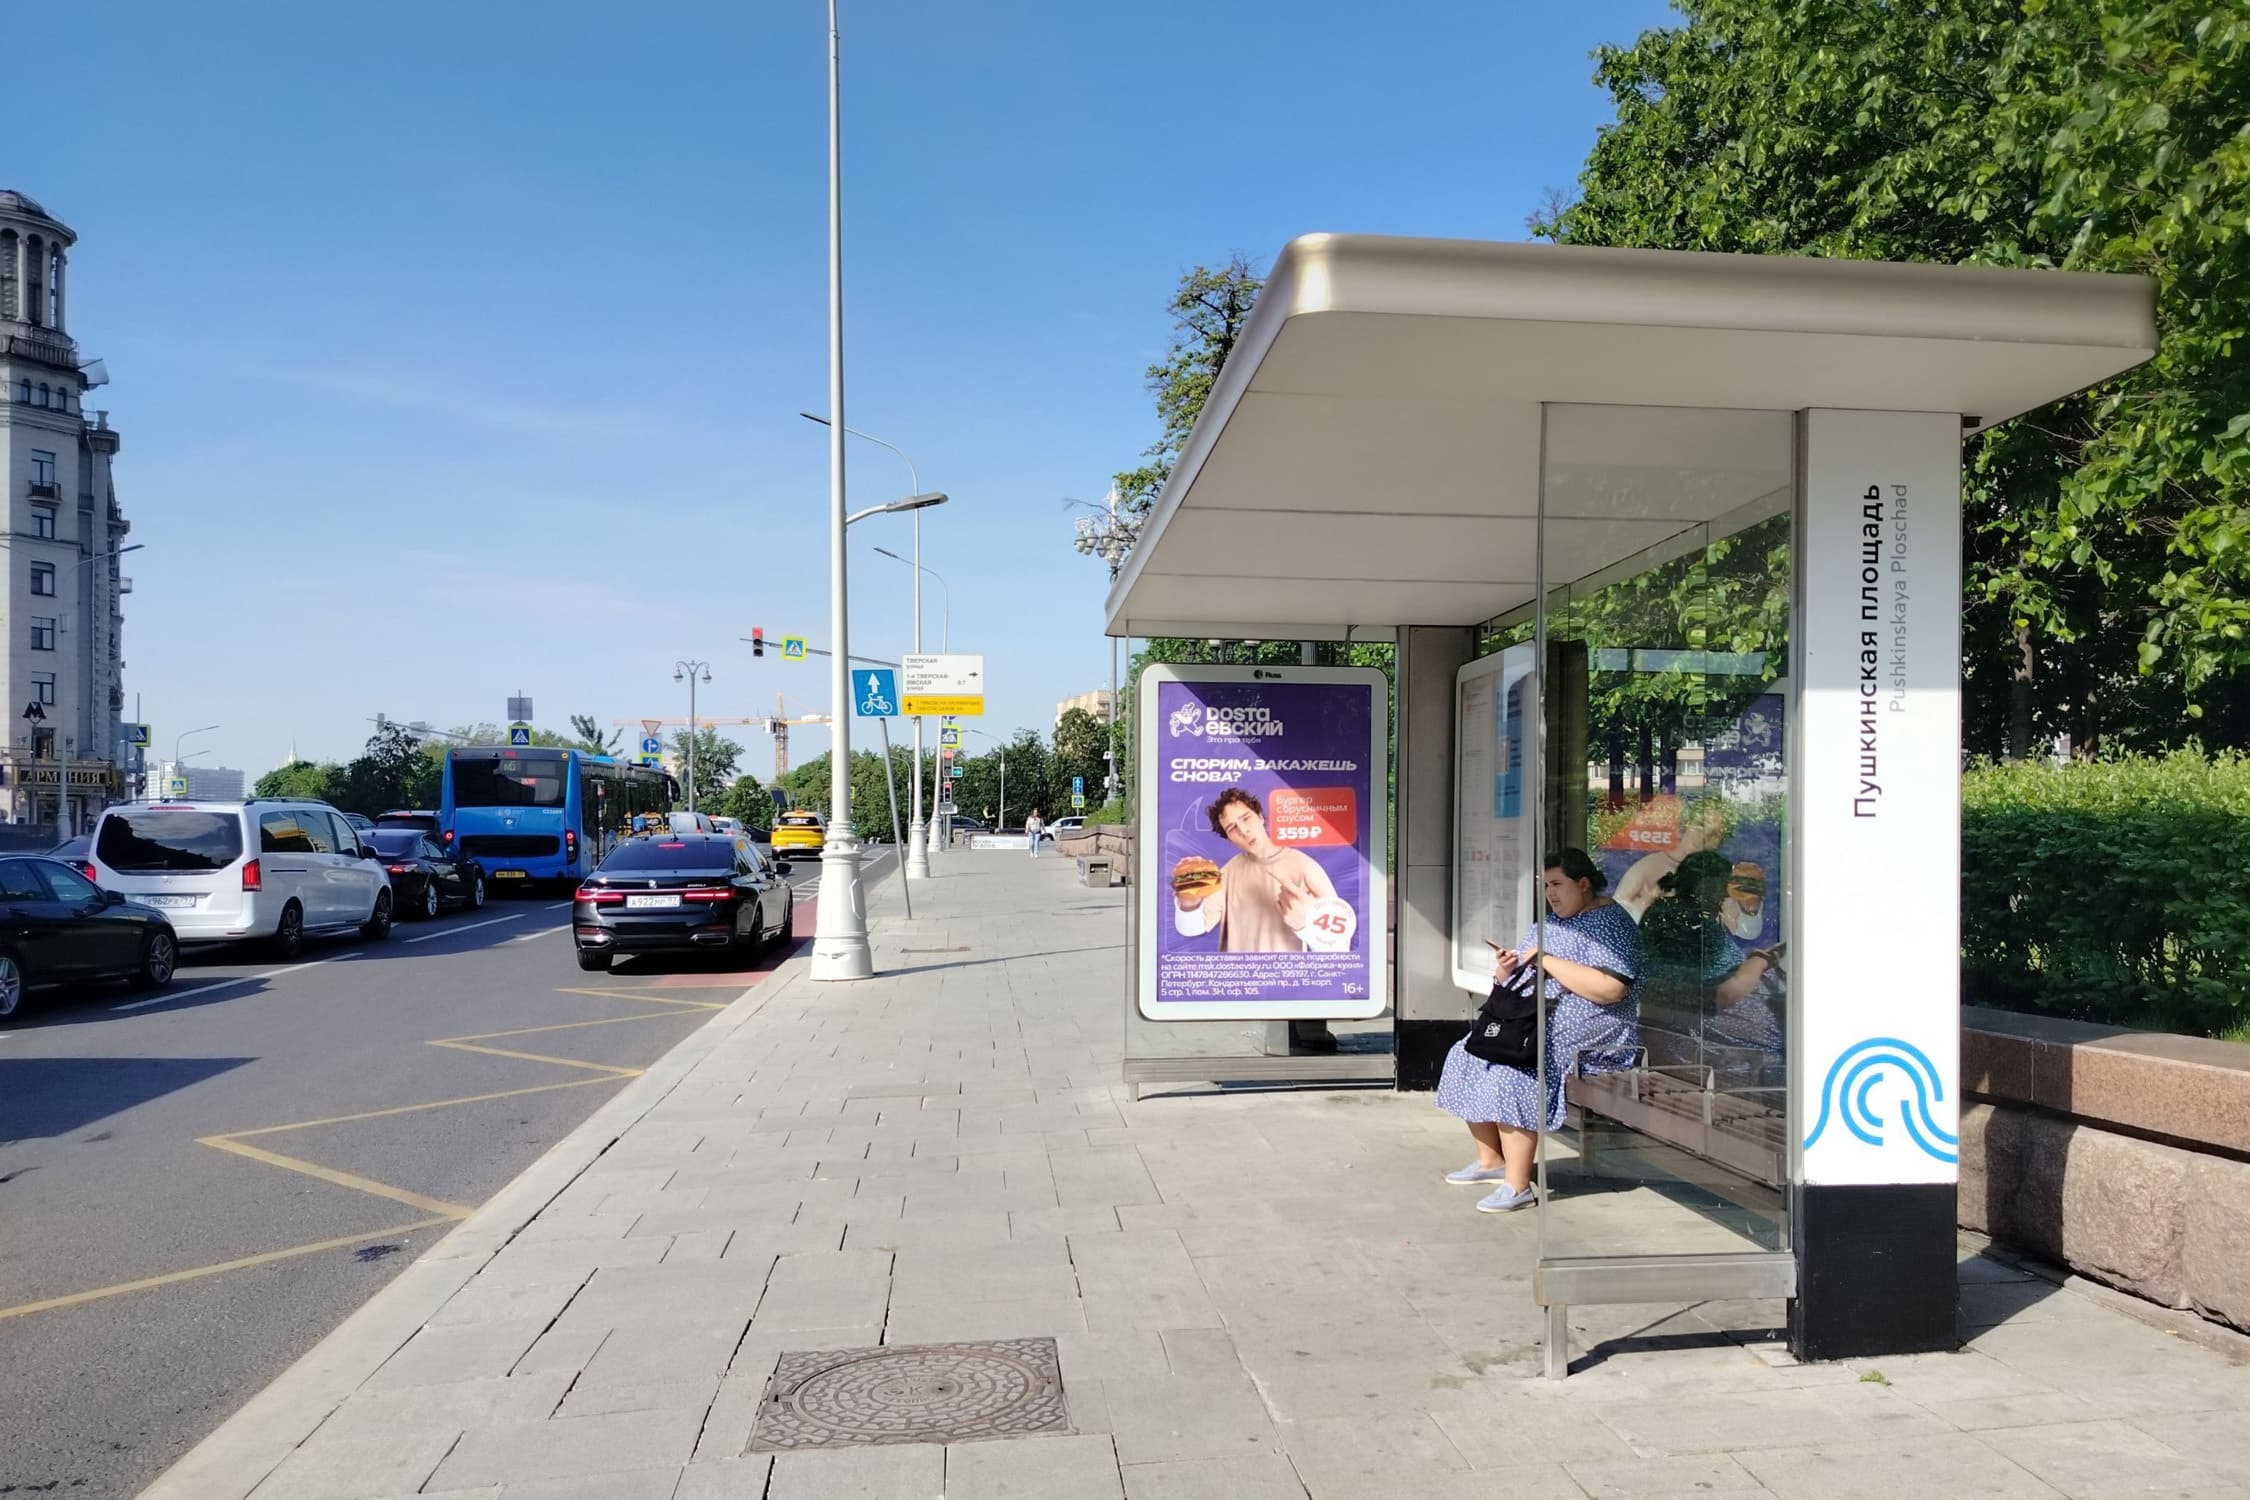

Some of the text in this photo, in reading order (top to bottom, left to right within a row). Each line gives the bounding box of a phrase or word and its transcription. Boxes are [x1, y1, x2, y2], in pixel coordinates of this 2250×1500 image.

[1889, 484, 1910, 712] Pushkinskaya Ploschad
[1854, 484, 1883, 818] Пушкинская площадь
[1171, 758, 1358, 771] СПОРИМ, ЗАКАЖЕШЬ
[26, 771, 100, 784] АРМНИЯ
[1170, 771, 1242, 783] СНОВА?
[1276, 815, 1314, 824] соусом
[1313, 913, 1347, 934] 45
[1205, 954, 1244, 962] доставки
[1307, 953, 1361, 962] подробности
[1198, 963, 1272, 971] msk.dostaevsky.ru
[1273, 961, 1293, 969] ООО
[1342, 983, 1364, 994] 16+
